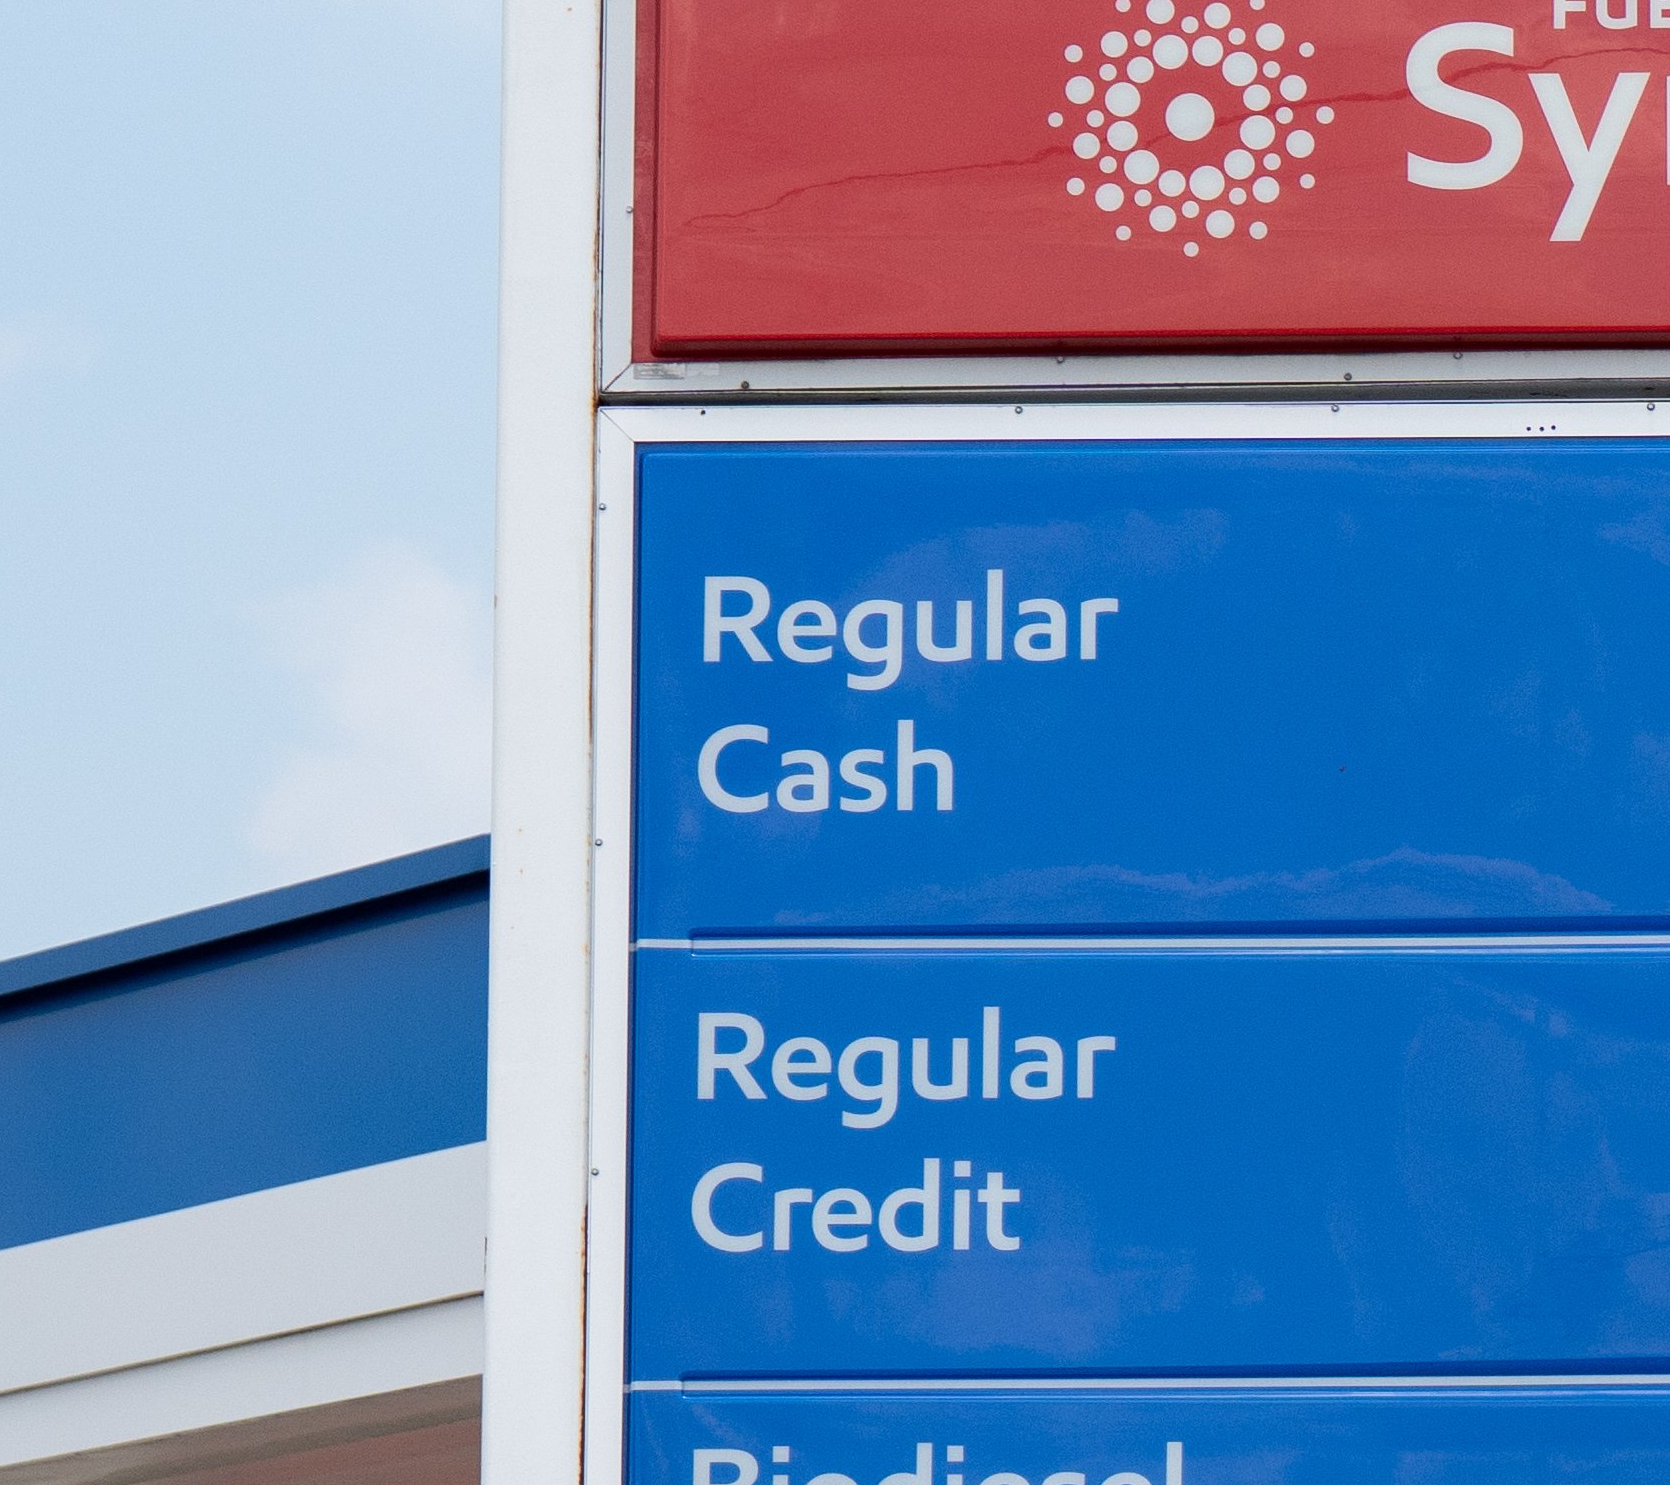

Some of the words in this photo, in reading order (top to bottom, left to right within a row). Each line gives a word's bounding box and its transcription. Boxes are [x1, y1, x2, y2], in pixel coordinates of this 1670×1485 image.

[703, 569, 1119, 691] Regular
[696, 719, 955, 813] Cash
[696, 1006, 1116, 1128] Regular
[691, 1158, 1022, 1252] Credit
